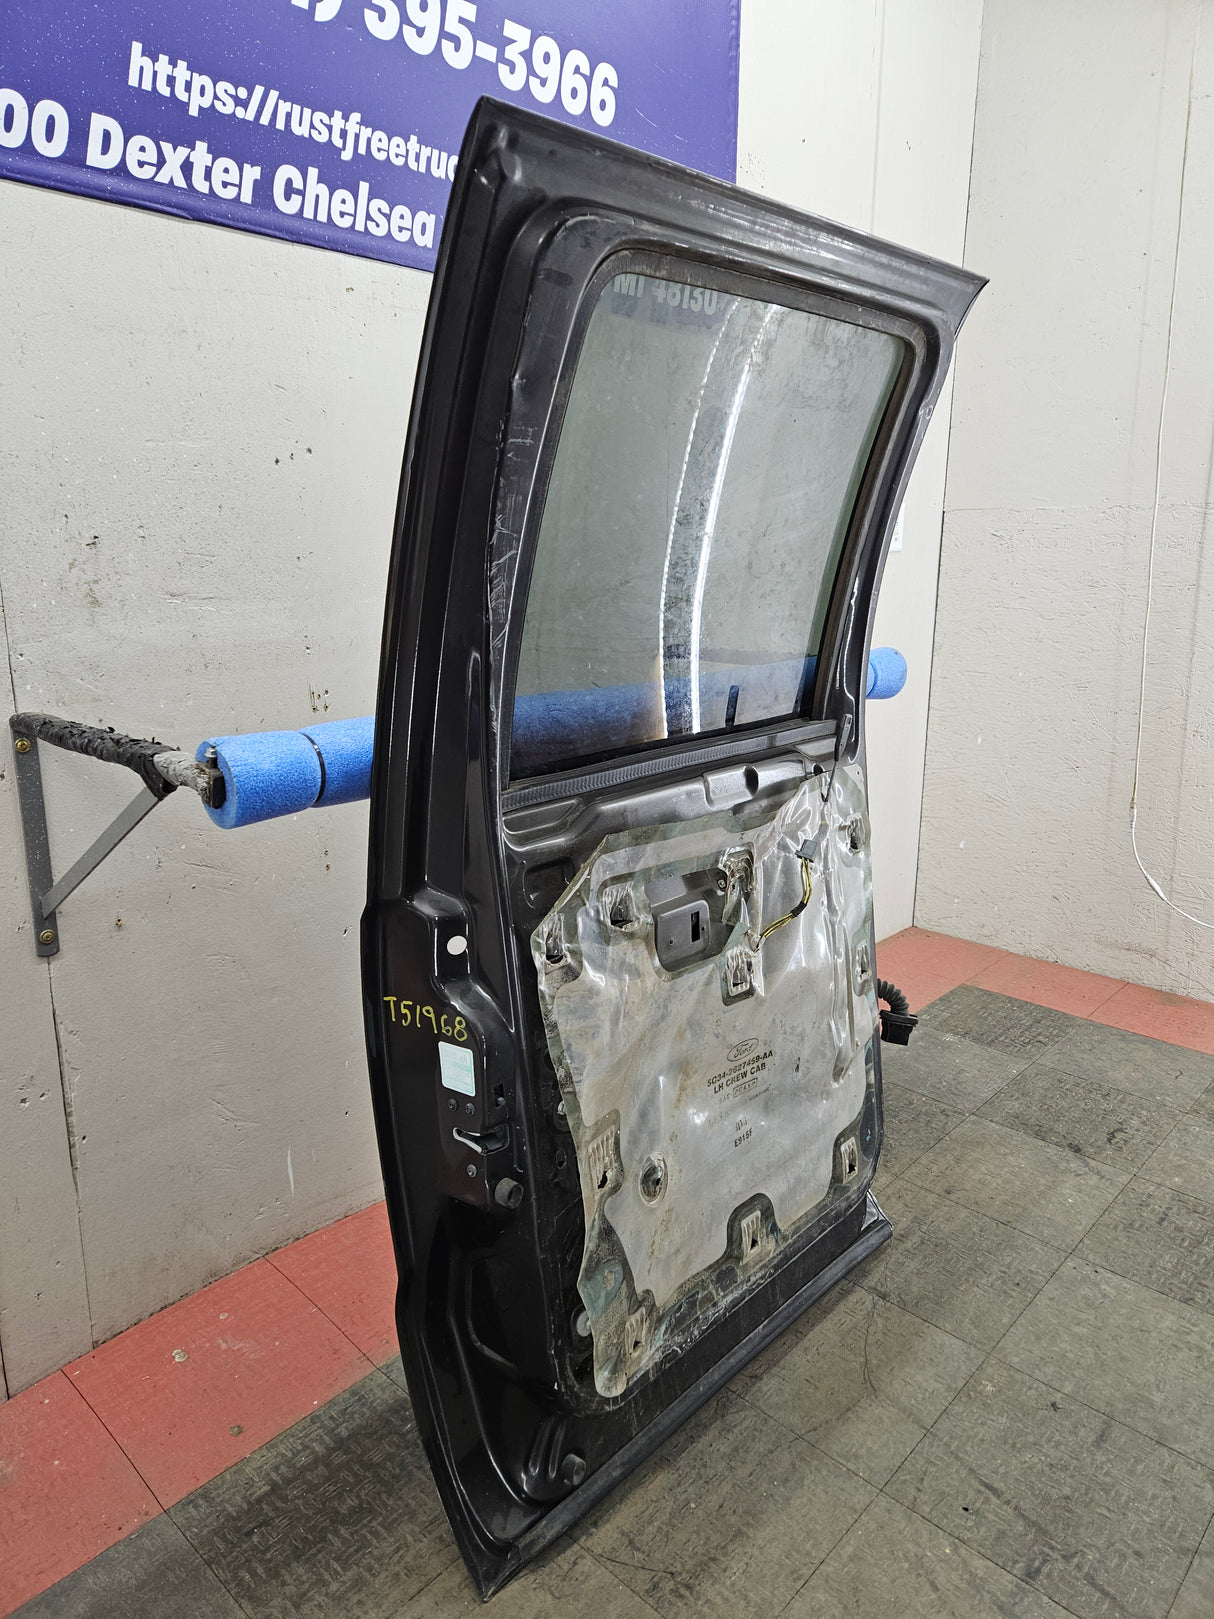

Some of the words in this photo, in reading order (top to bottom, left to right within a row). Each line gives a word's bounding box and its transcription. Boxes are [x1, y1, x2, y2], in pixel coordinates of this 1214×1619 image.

[364, 0, 618, 127] 395-3966
[86, 112, 261, 205] Dexter
[273, 164, 436, 249] Chelsea
[614, 274, 646, 299] MI
[383, 996, 468, 1042] T51968
[713, 1082, 724, 1095] LH
[725, 1070, 748, 1088] CREW
[750, 1062, 766, 1076] CAB
